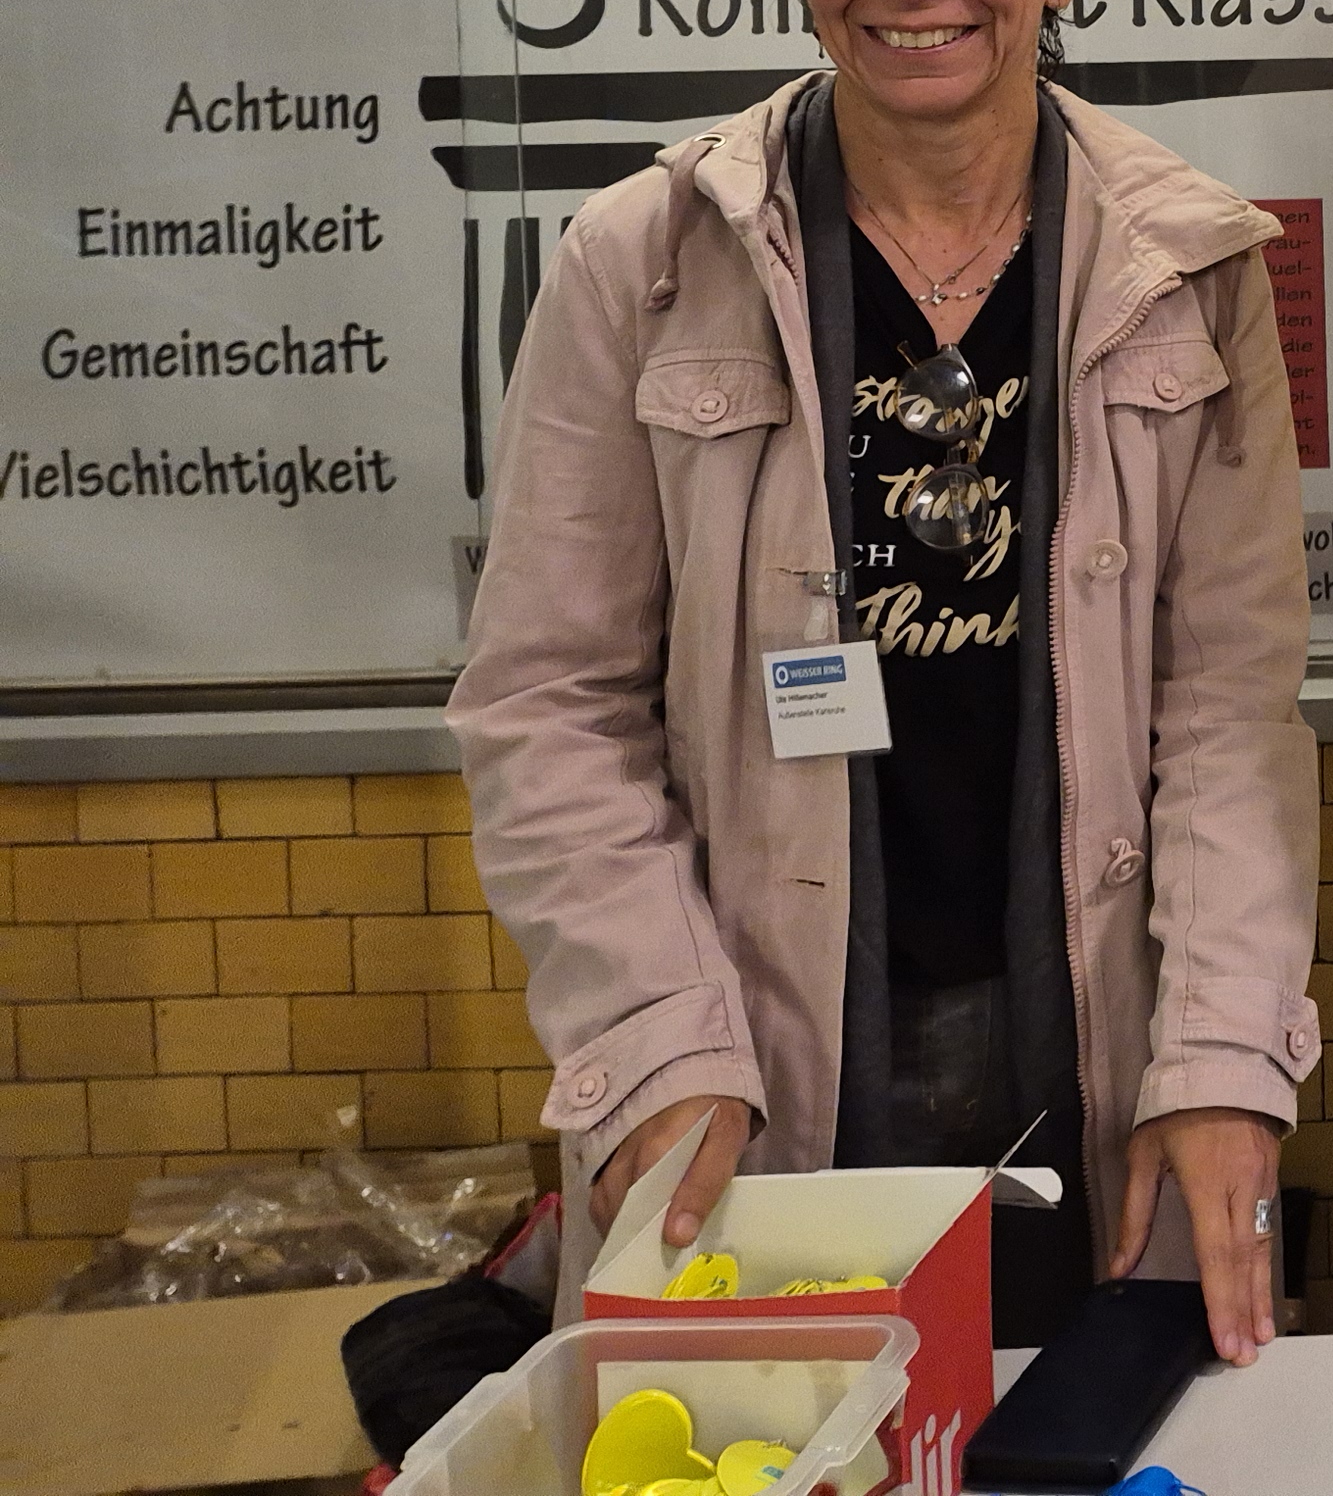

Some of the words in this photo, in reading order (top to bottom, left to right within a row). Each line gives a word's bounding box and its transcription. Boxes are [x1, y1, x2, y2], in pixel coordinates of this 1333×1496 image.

[164, 80, 380, 144] Achtung
[77, 202, 384, 268] Einmaligkeit
[42, 322, 388, 380] Gemeinschaft
[822, 663, 843, 675] RING
